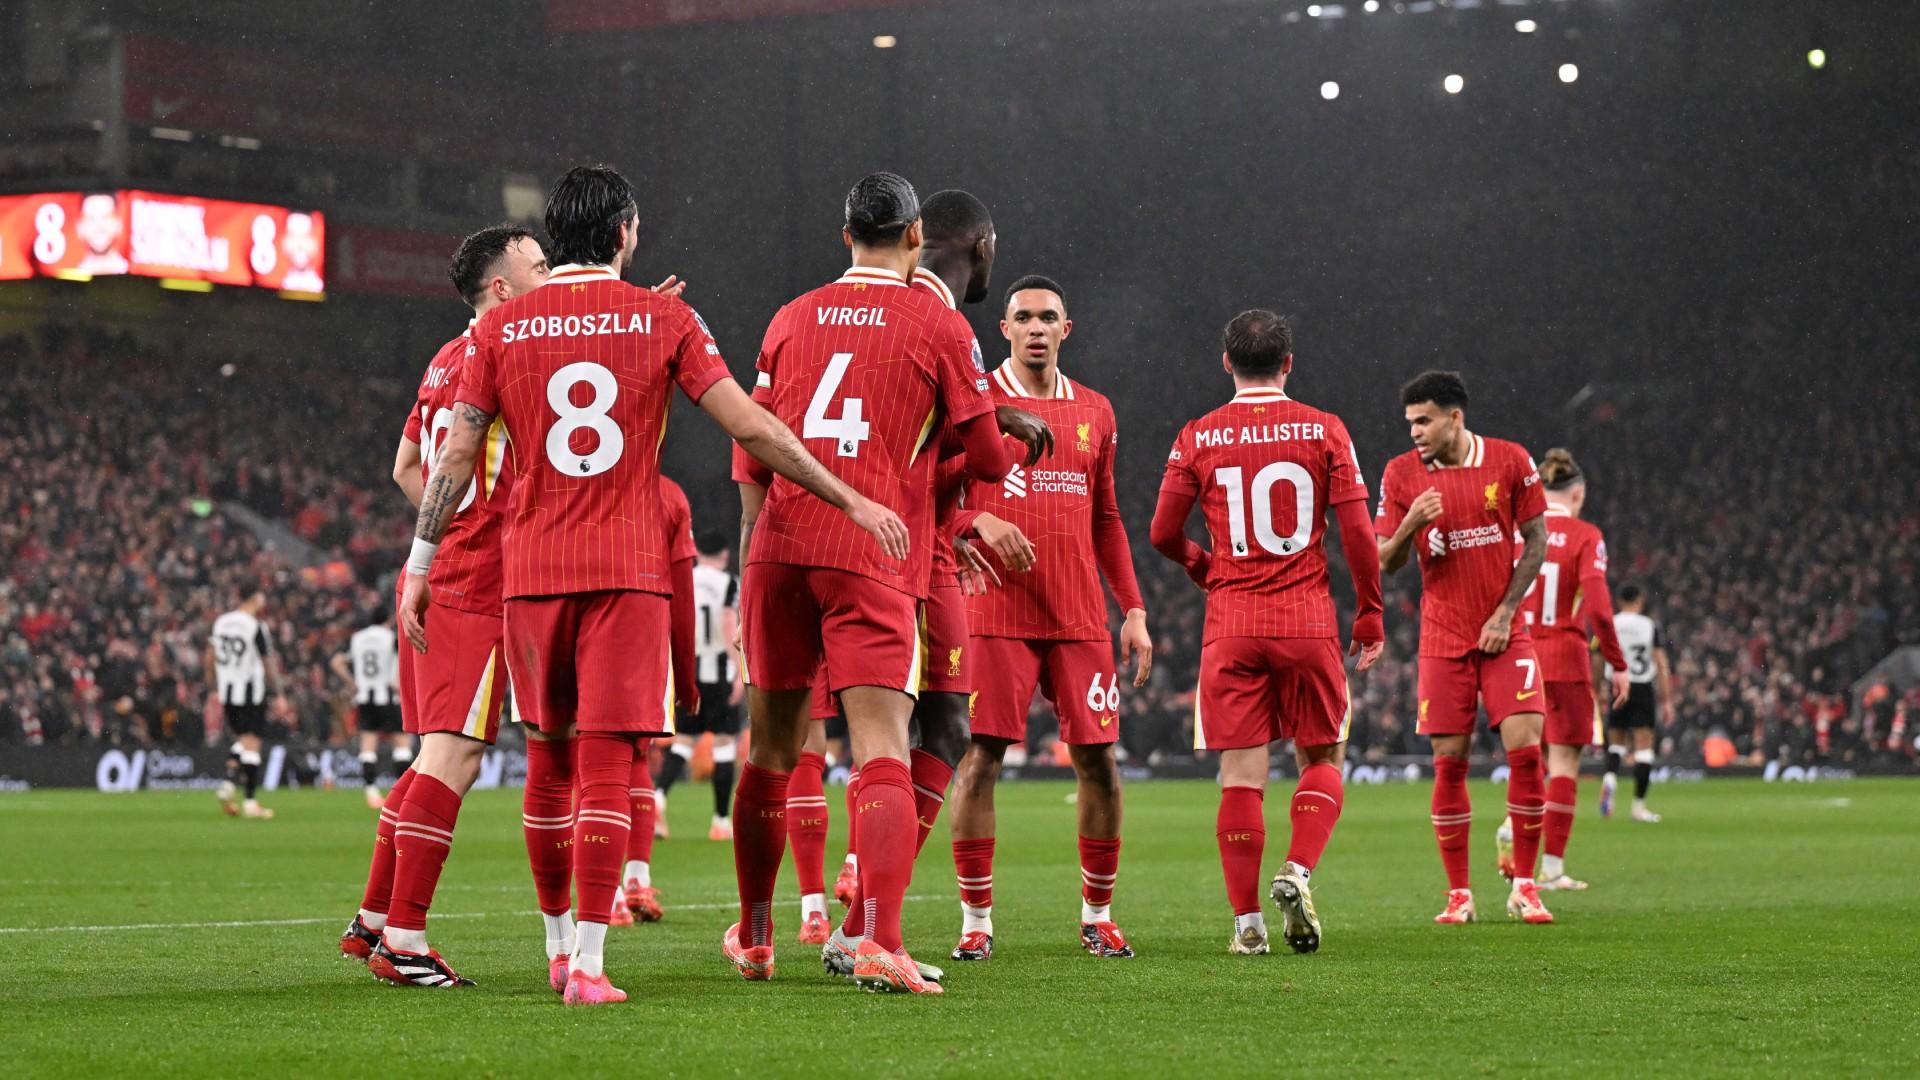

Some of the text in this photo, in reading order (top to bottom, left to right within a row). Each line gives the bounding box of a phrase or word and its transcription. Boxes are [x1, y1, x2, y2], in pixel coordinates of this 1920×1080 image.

[33, 203, 66, 264] 8
[250, 214, 277, 275] 8
[817, 306, 887, 327] VIRGIL
[502, 313, 651, 344] SZOBOSZLAI
[802, 352, 870, 458] 4
[546, 361, 625, 477] 8
[1195, 423, 1325, 448] MAC ALLISTER
[1031, 469, 1087, 484] standard
[1031, 480, 1088, 496] chartered
[1214, 461, 1314, 557] 10
[1447, 523, 1499, 541] standard
[1449, 530, 1504, 551] chartered
[214, 634, 247, 666] 39
[361, 650, 379, 677] 8
[1515, 658, 1535, 690] 7
[1086, 672, 1120, 712] 66
[760, 809, 785, 819] LFC
[859, 800, 884, 814] LFC
[1296, 804, 1320, 813] LFC
[801, 818, 823, 826] LFC
[583, 834, 609, 844] LFC
[1226, 833, 1251, 842] LFC
